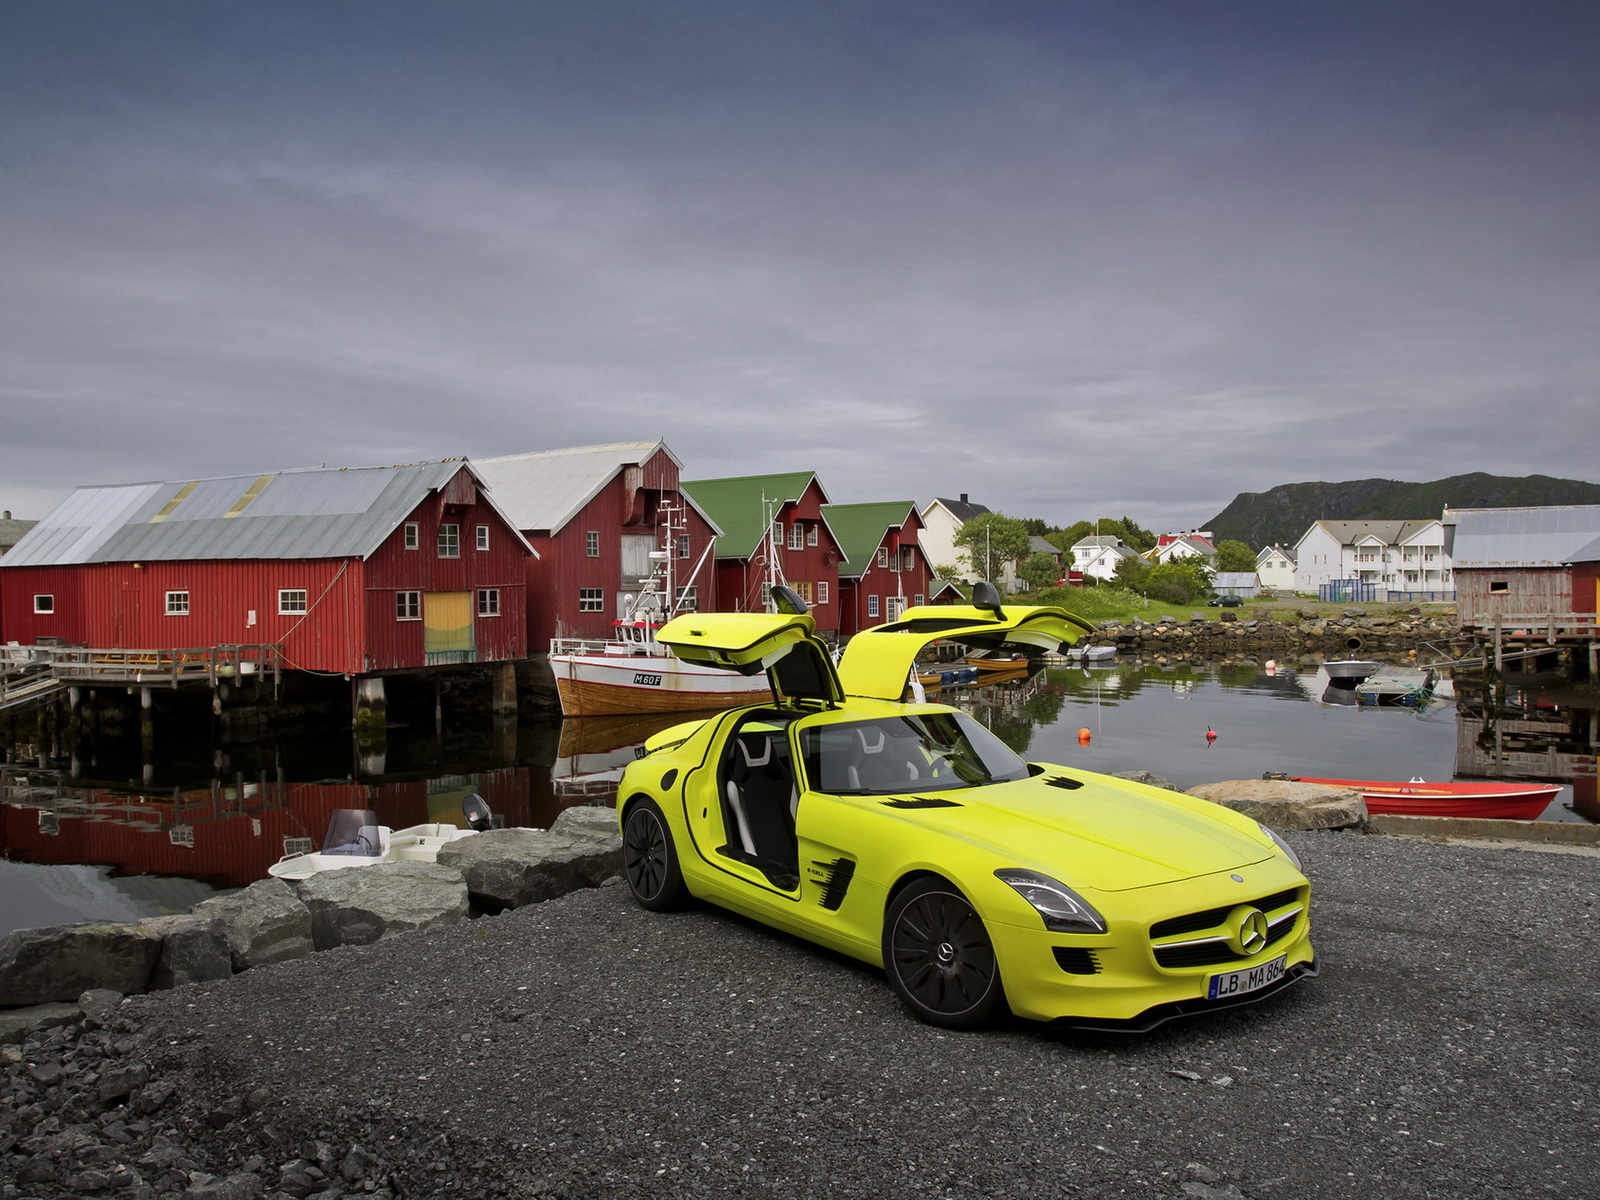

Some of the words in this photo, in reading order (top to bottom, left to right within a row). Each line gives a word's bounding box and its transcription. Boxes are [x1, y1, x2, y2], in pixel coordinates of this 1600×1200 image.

[1219, 975, 1239, 995] LB
[1248, 967, 1264, 989] MA
[1267, 957, 1286, 981] 864
